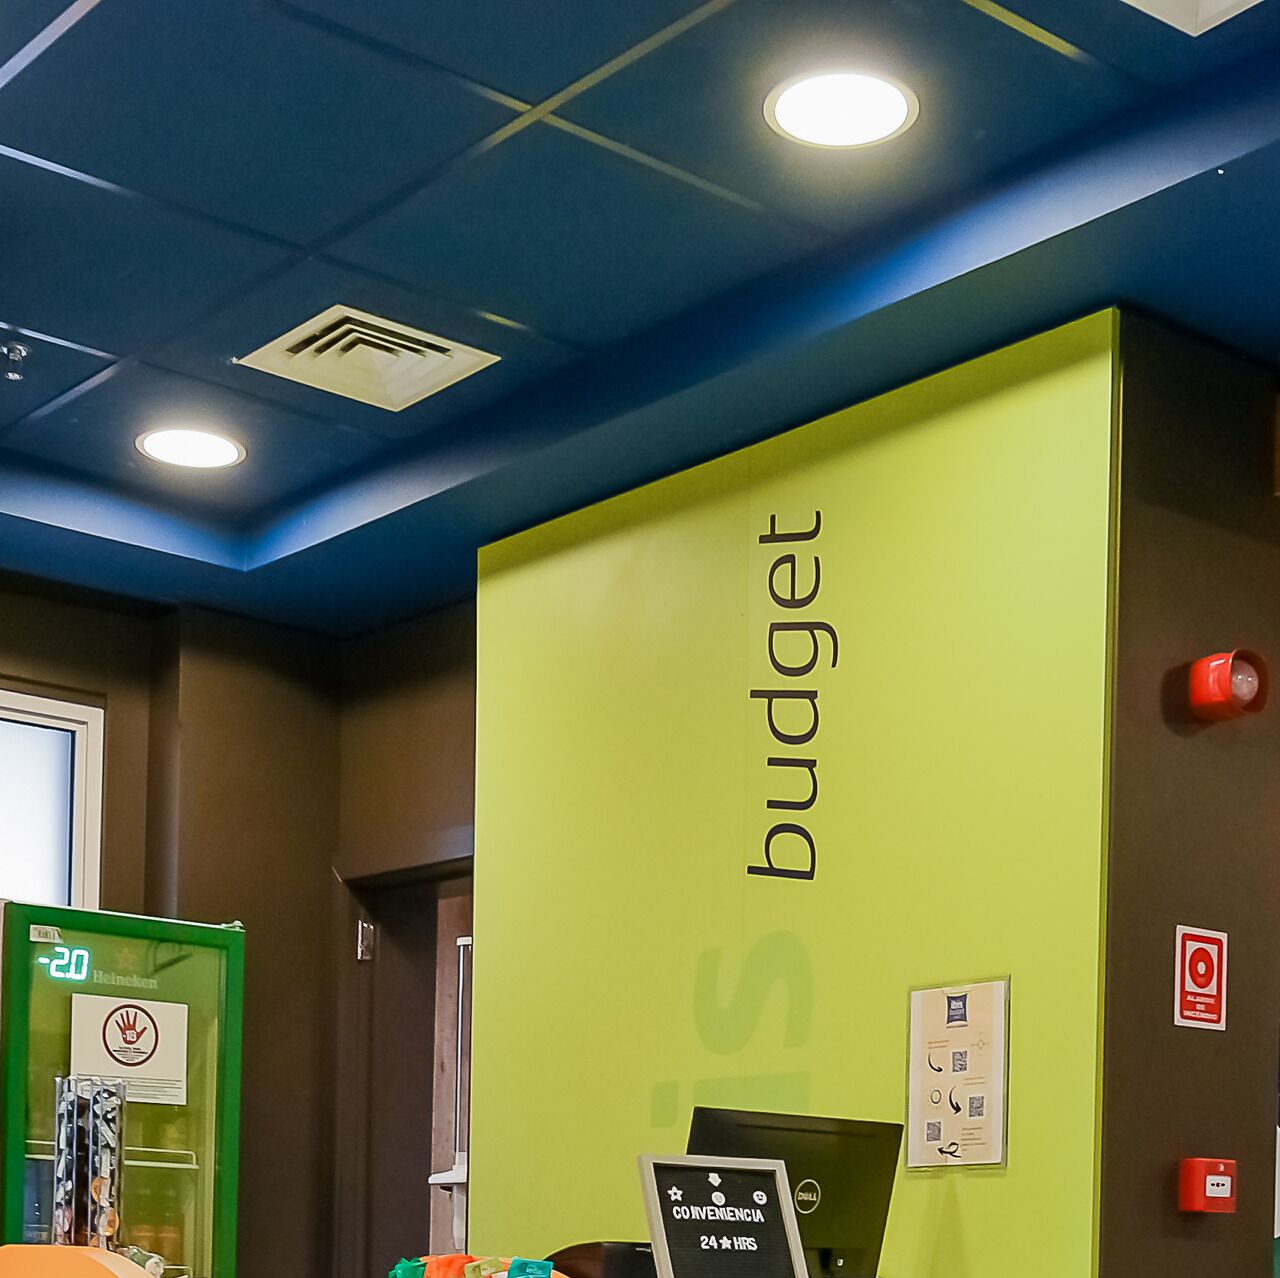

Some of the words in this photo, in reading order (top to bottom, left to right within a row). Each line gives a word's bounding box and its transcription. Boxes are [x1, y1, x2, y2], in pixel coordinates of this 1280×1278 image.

[746, 510, 838, 881] budget
[93, 969, 158, 989] Heineken
[672, 1205, 765, 1223] CONVENIENCIA
[700, 1235, 718, 1250] 24
[733, 1236, 758, 1251] HRS
